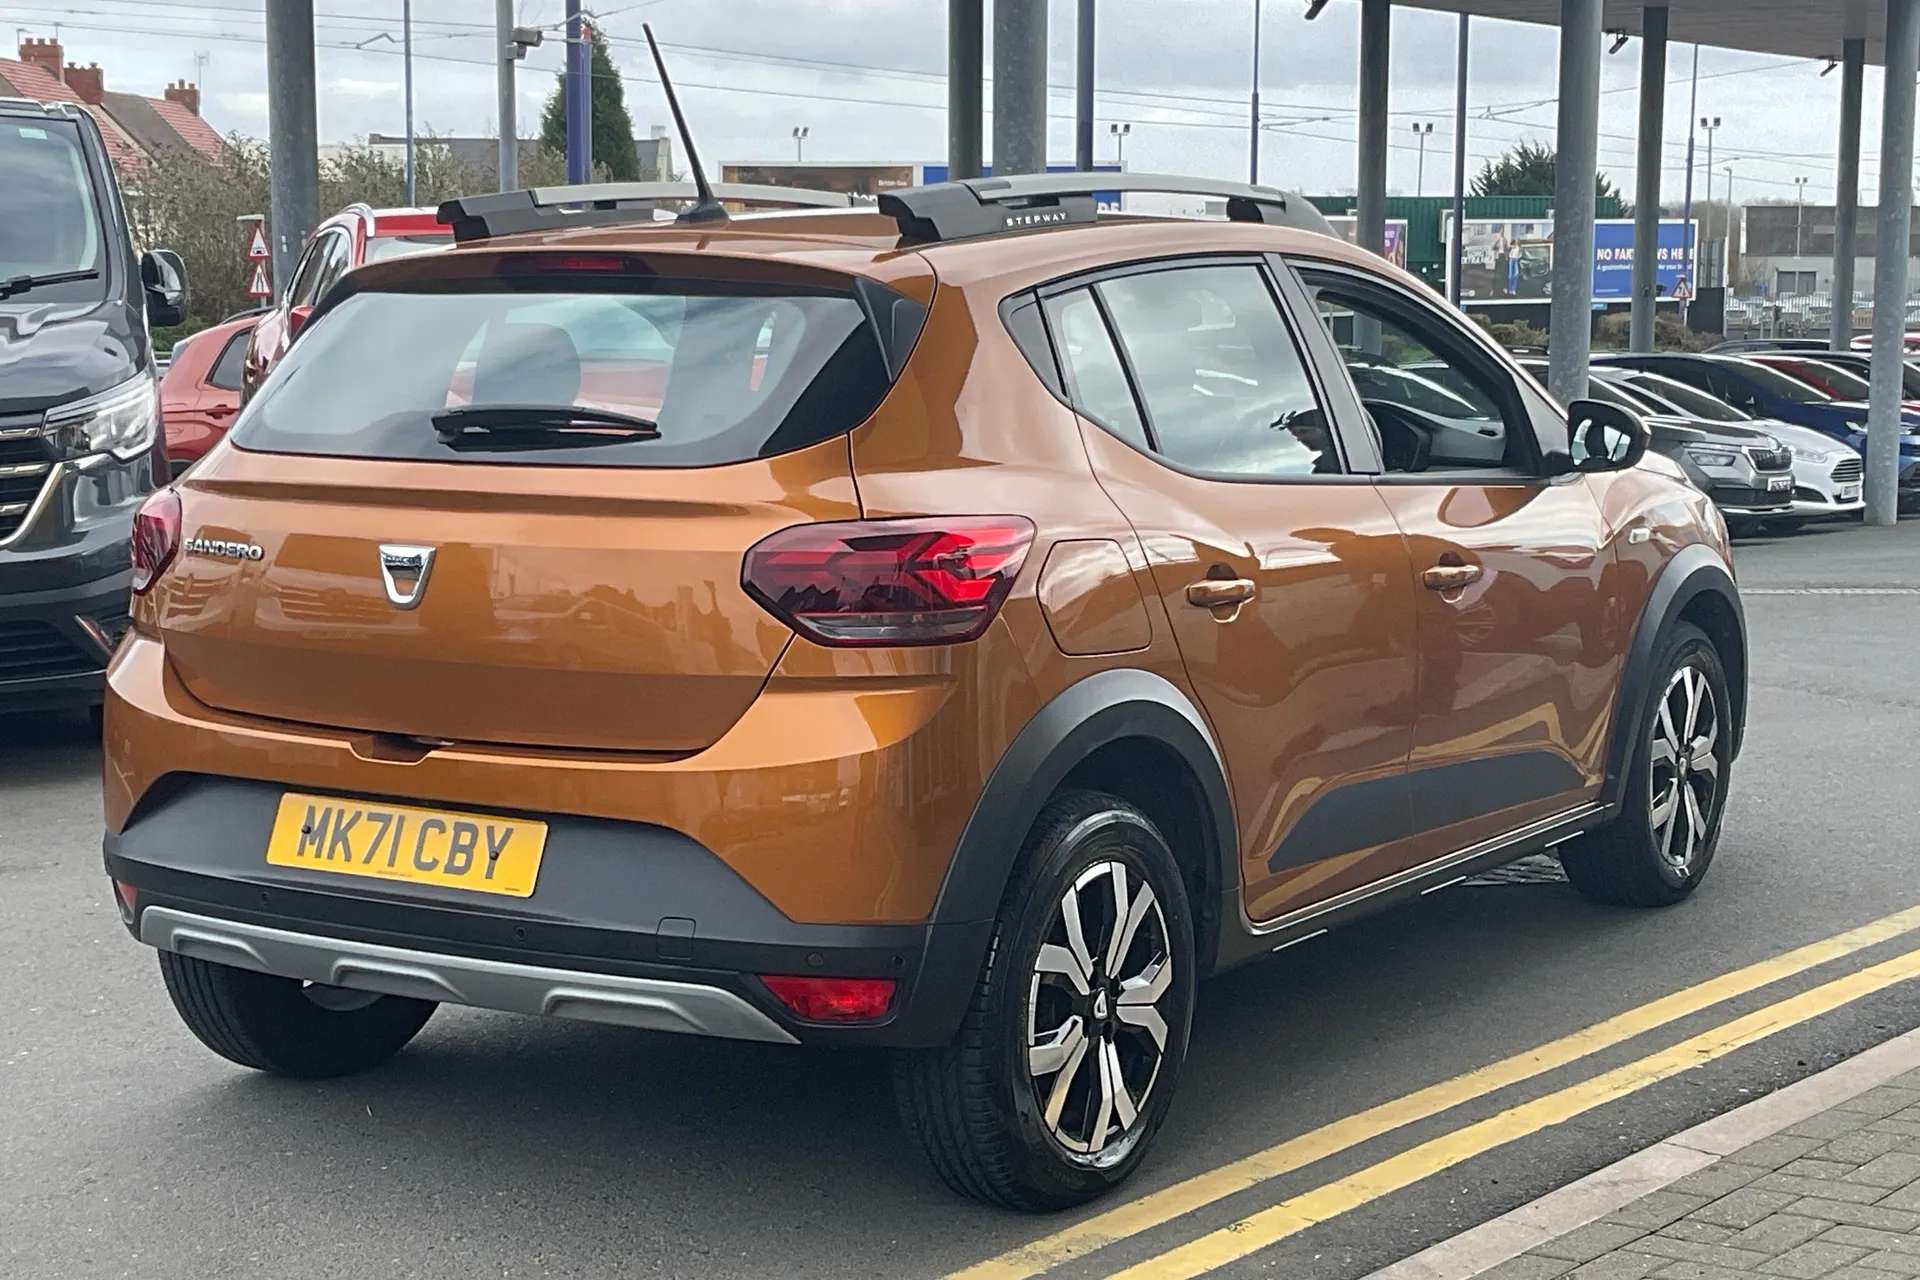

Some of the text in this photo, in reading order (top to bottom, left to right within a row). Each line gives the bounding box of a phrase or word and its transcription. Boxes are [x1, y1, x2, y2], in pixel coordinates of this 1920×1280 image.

[1006, 212, 1067, 227] STEPWAY
[1596, 247, 1612, 261] NO
[184, 538, 264, 560] SANDERO
[297, 805, 514, 880] MK71 CBY
